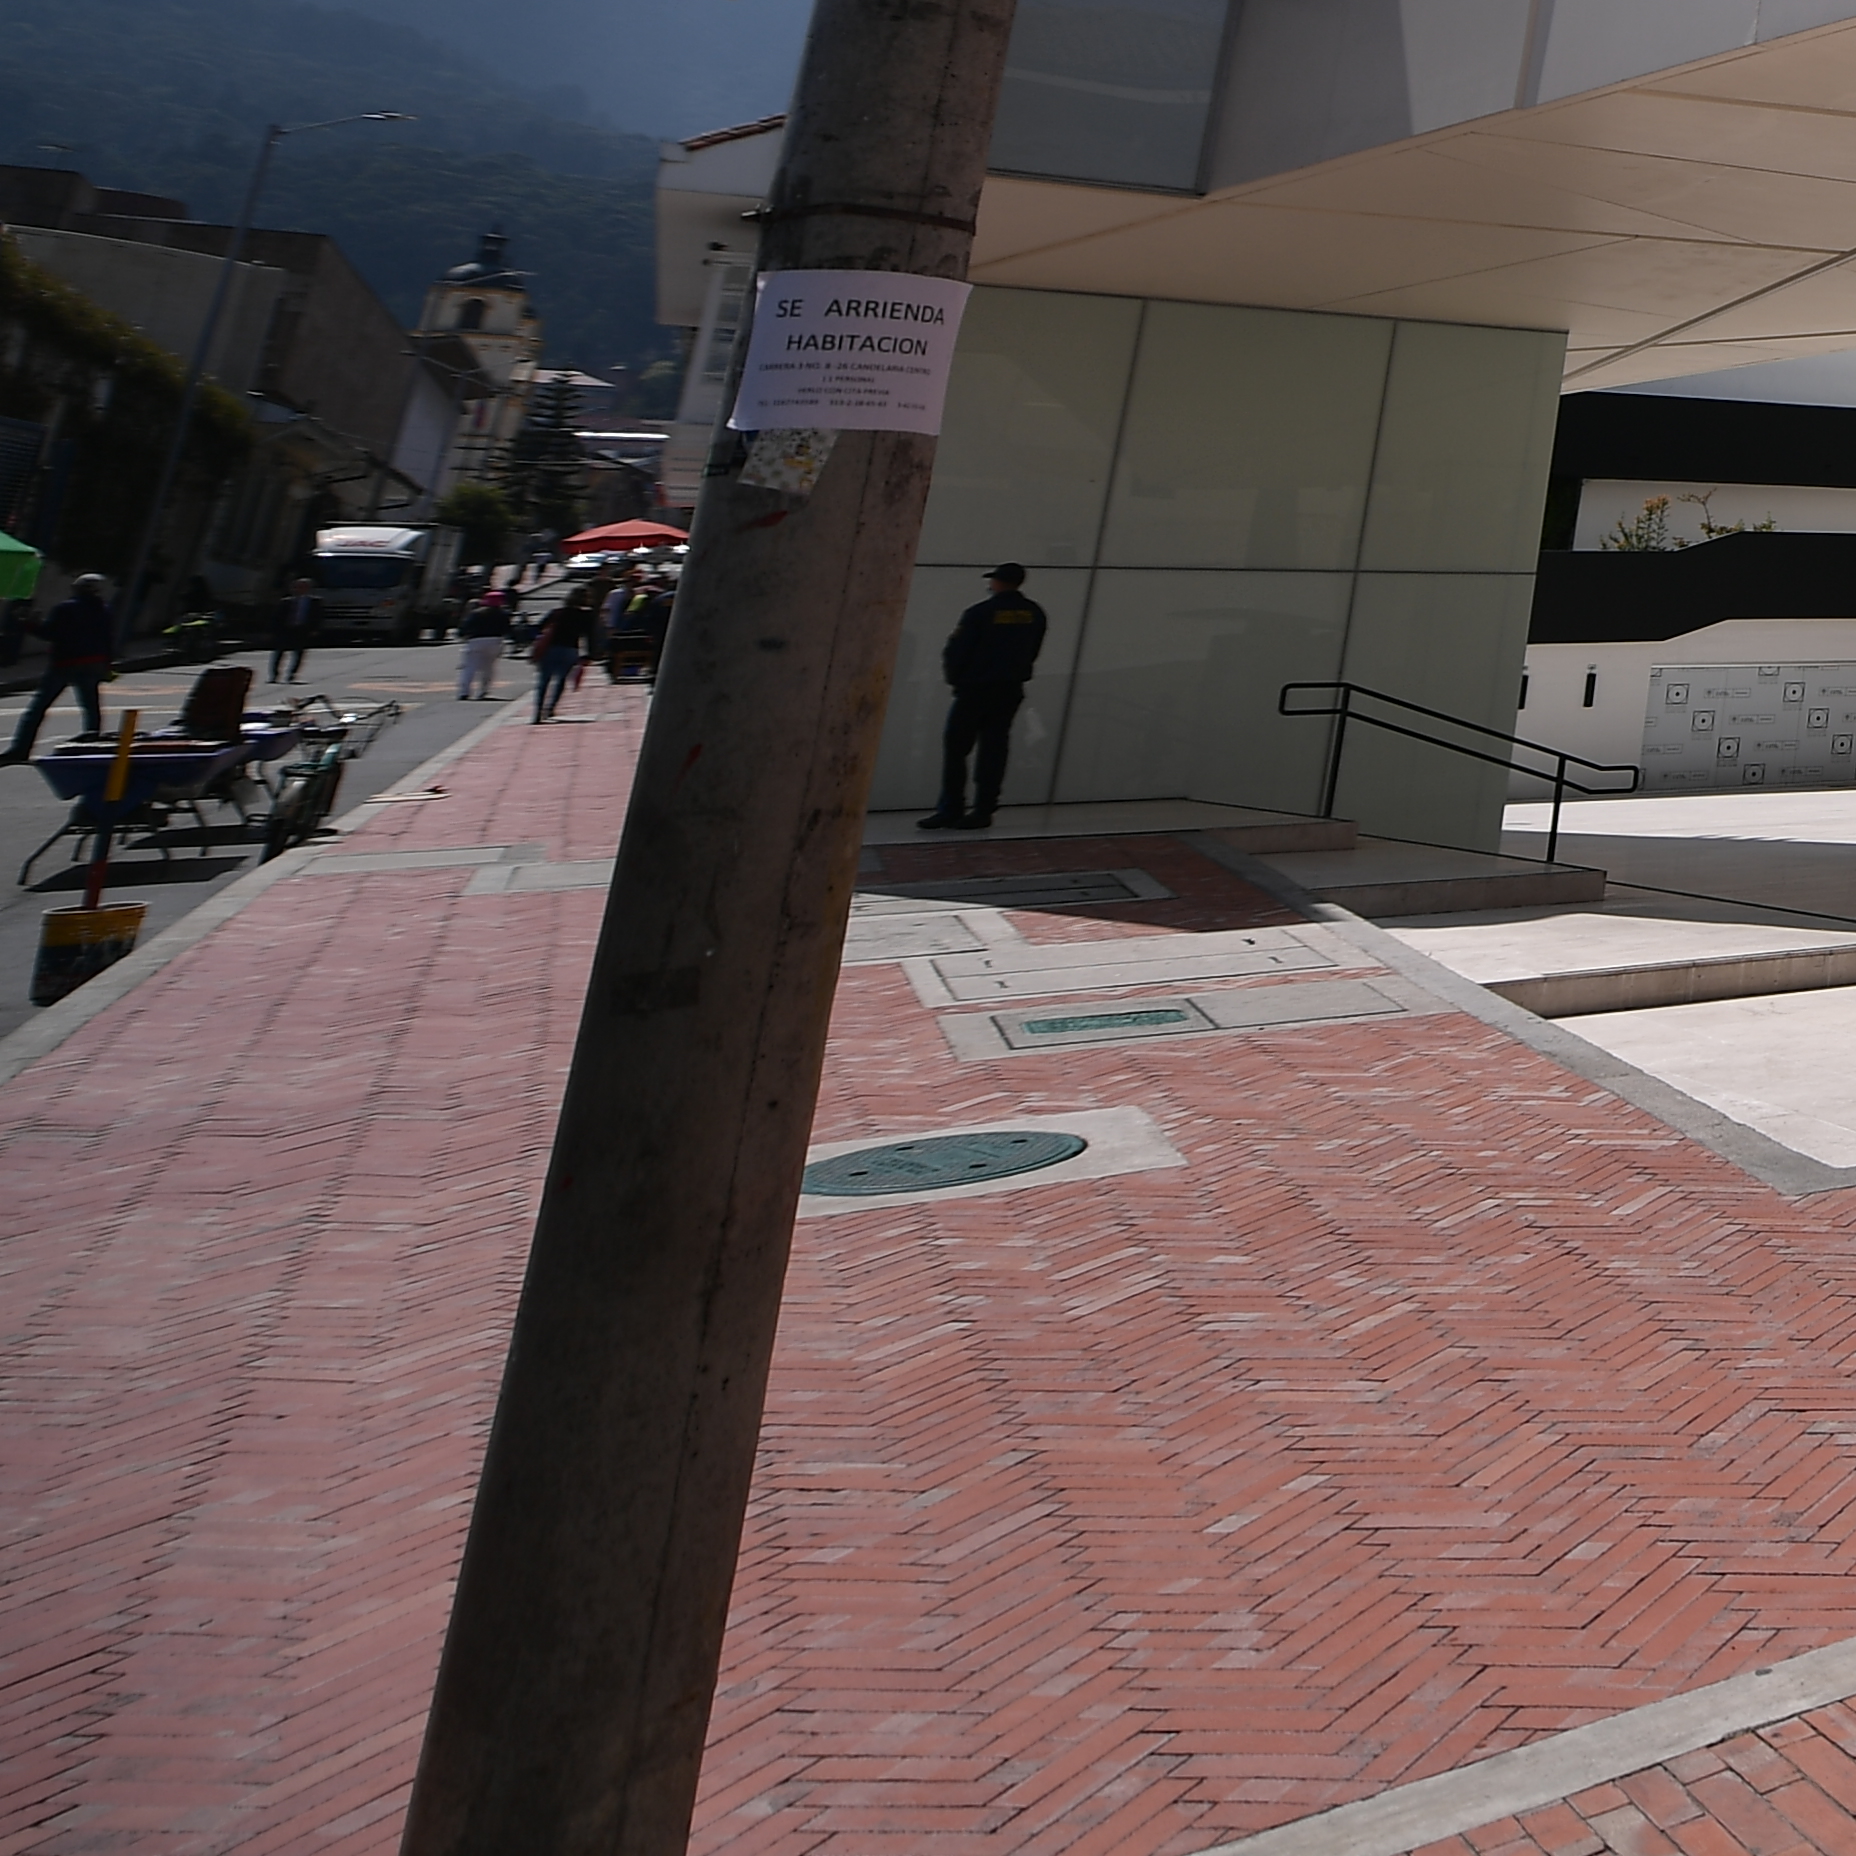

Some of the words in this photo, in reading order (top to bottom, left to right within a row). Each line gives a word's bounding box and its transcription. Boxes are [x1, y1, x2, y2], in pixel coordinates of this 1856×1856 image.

[775, 299, 804, 318] SE
[824, 299, 945, 325] ARRIENDA
[786, 334, 928, 356] HABITACION
